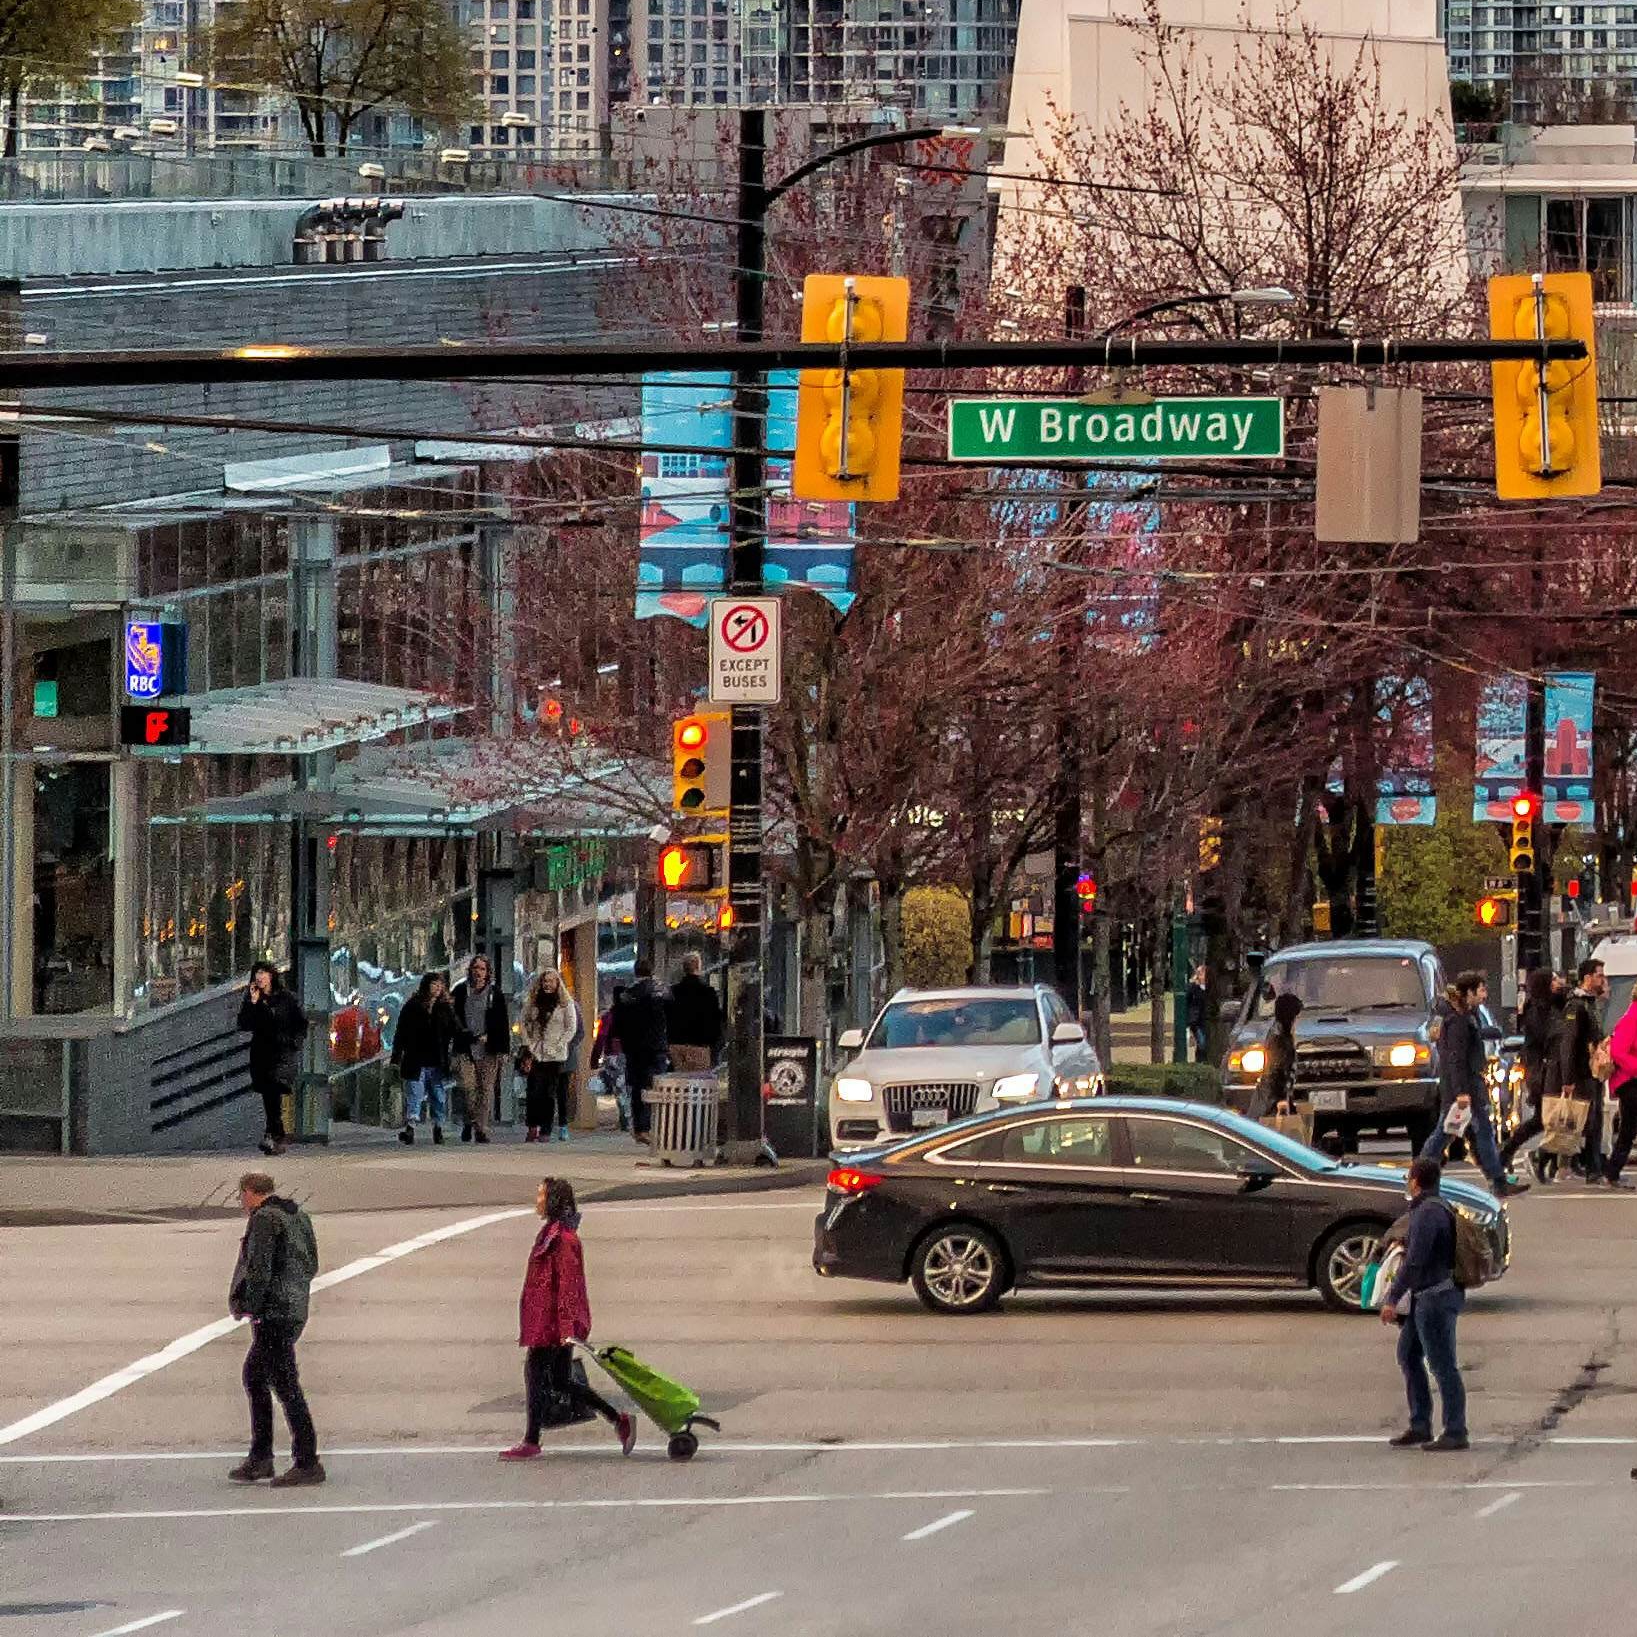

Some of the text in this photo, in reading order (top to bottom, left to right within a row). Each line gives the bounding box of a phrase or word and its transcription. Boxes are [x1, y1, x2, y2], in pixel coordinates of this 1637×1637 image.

[979, 405, 1254, 451] W Broadway
[720, 658, 769, 672] EXCEPT
[130, 675, 158, 692] RBC
[722, 675, 767, 688] BUSES
